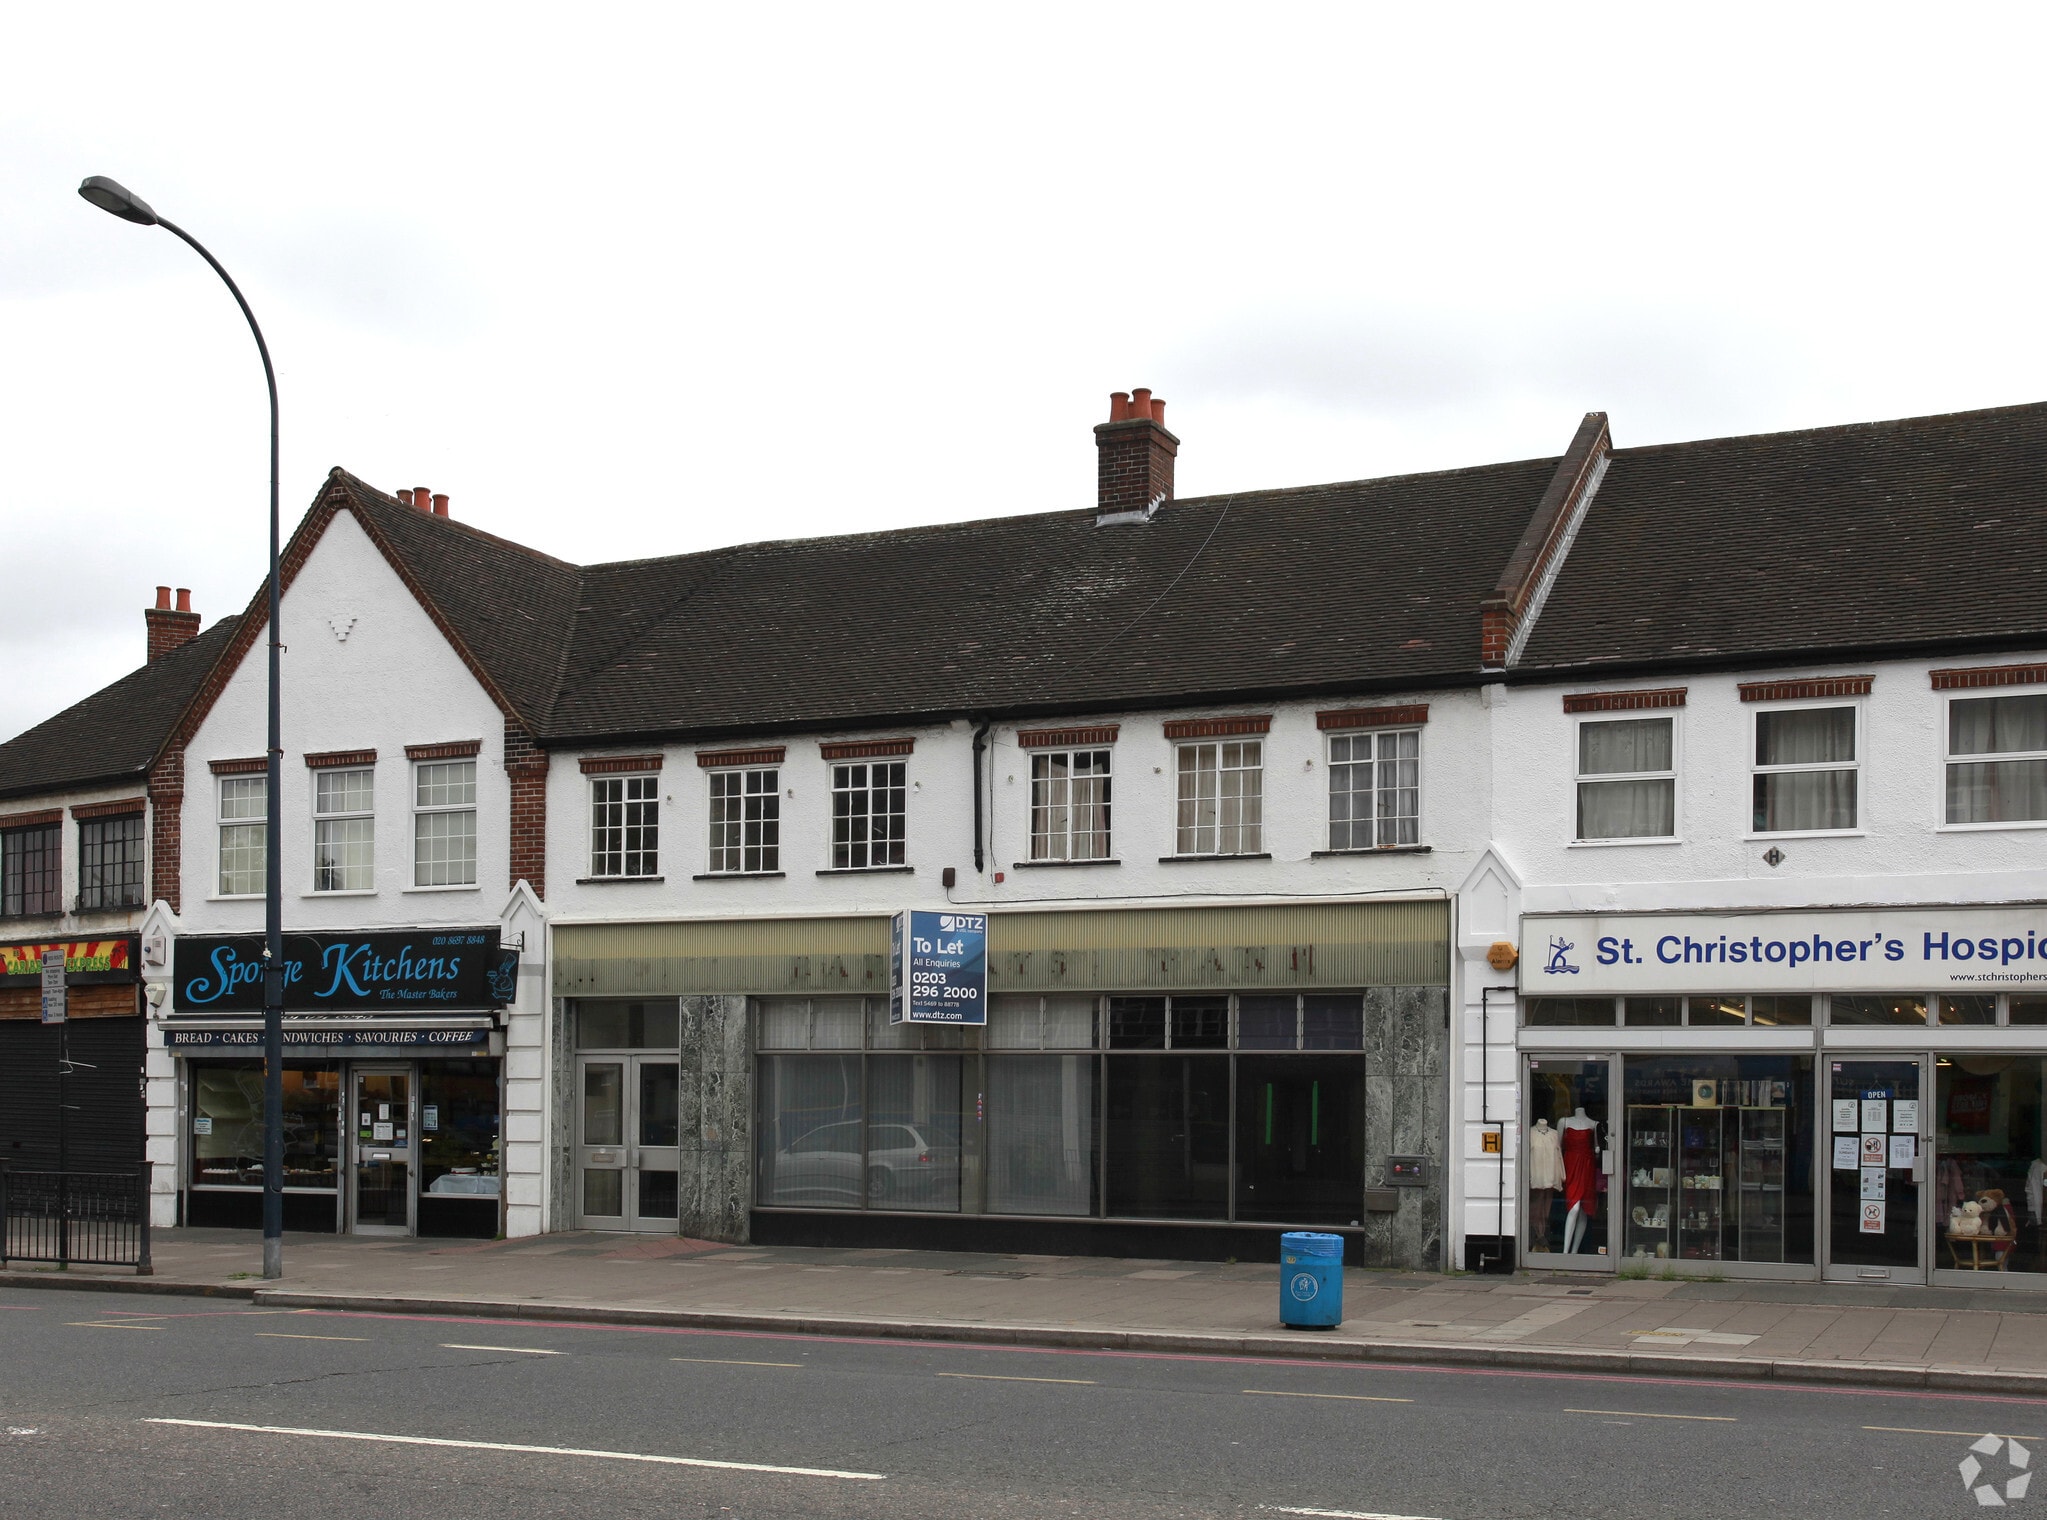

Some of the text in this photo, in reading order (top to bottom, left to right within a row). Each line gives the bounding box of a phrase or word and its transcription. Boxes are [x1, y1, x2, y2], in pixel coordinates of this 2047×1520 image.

[956, 916, 984, 930] DTZ
[432, 937, 446, 946] 020
[913, 936, 932, 954] To
[937, 938, 964, 955] Let
[1596, 936, 1642, 965] St.
[1656, 932, 1904, 968] Christopher's
[66, 956, 111, 972] EXPRESS
[913, 958, 960, 968] All Enquiries
[314, 944, 461, 998] Kitchens
[912, 972, 946, 984] 0203
[380, 988, 458, 1000] The Master Bakers
[912, 986, 939, 997] 296
[944, 987, 978, 999] 2000
[912, 1011, 962, 1020] www.dtz.com
[175, 1032, 474, 1044] BREAD CAKES NDWICHES SAVOURIES COFFEE
[1868, 1090, 1886, 1098] OPEN
[1484, 1134, 1498, 1152] H
